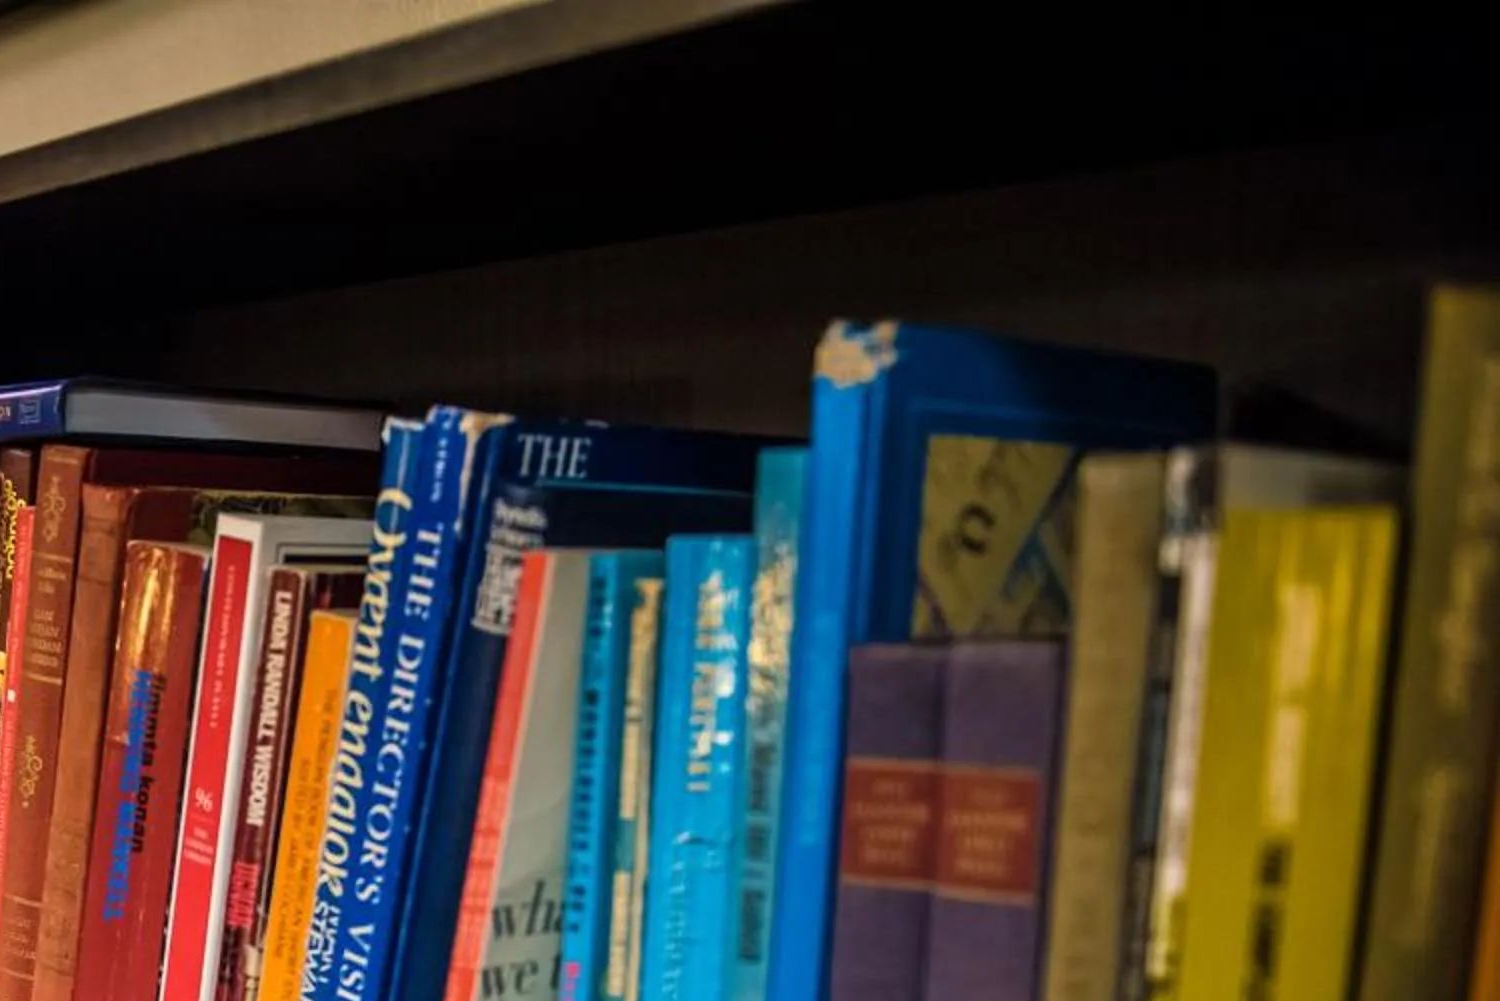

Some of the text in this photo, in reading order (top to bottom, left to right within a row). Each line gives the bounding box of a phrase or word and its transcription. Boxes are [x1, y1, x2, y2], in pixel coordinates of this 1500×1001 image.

[518, 433, 592, 479] THE
[405, 523, 444, 621] THE
[246, 590, 293, 827] LINDA RANDALL WISDOM
[354, 634, 425, 905] DIRECTOR'S
[131, 776, 157, 854] konan
[481, 959, 540, 999] we
